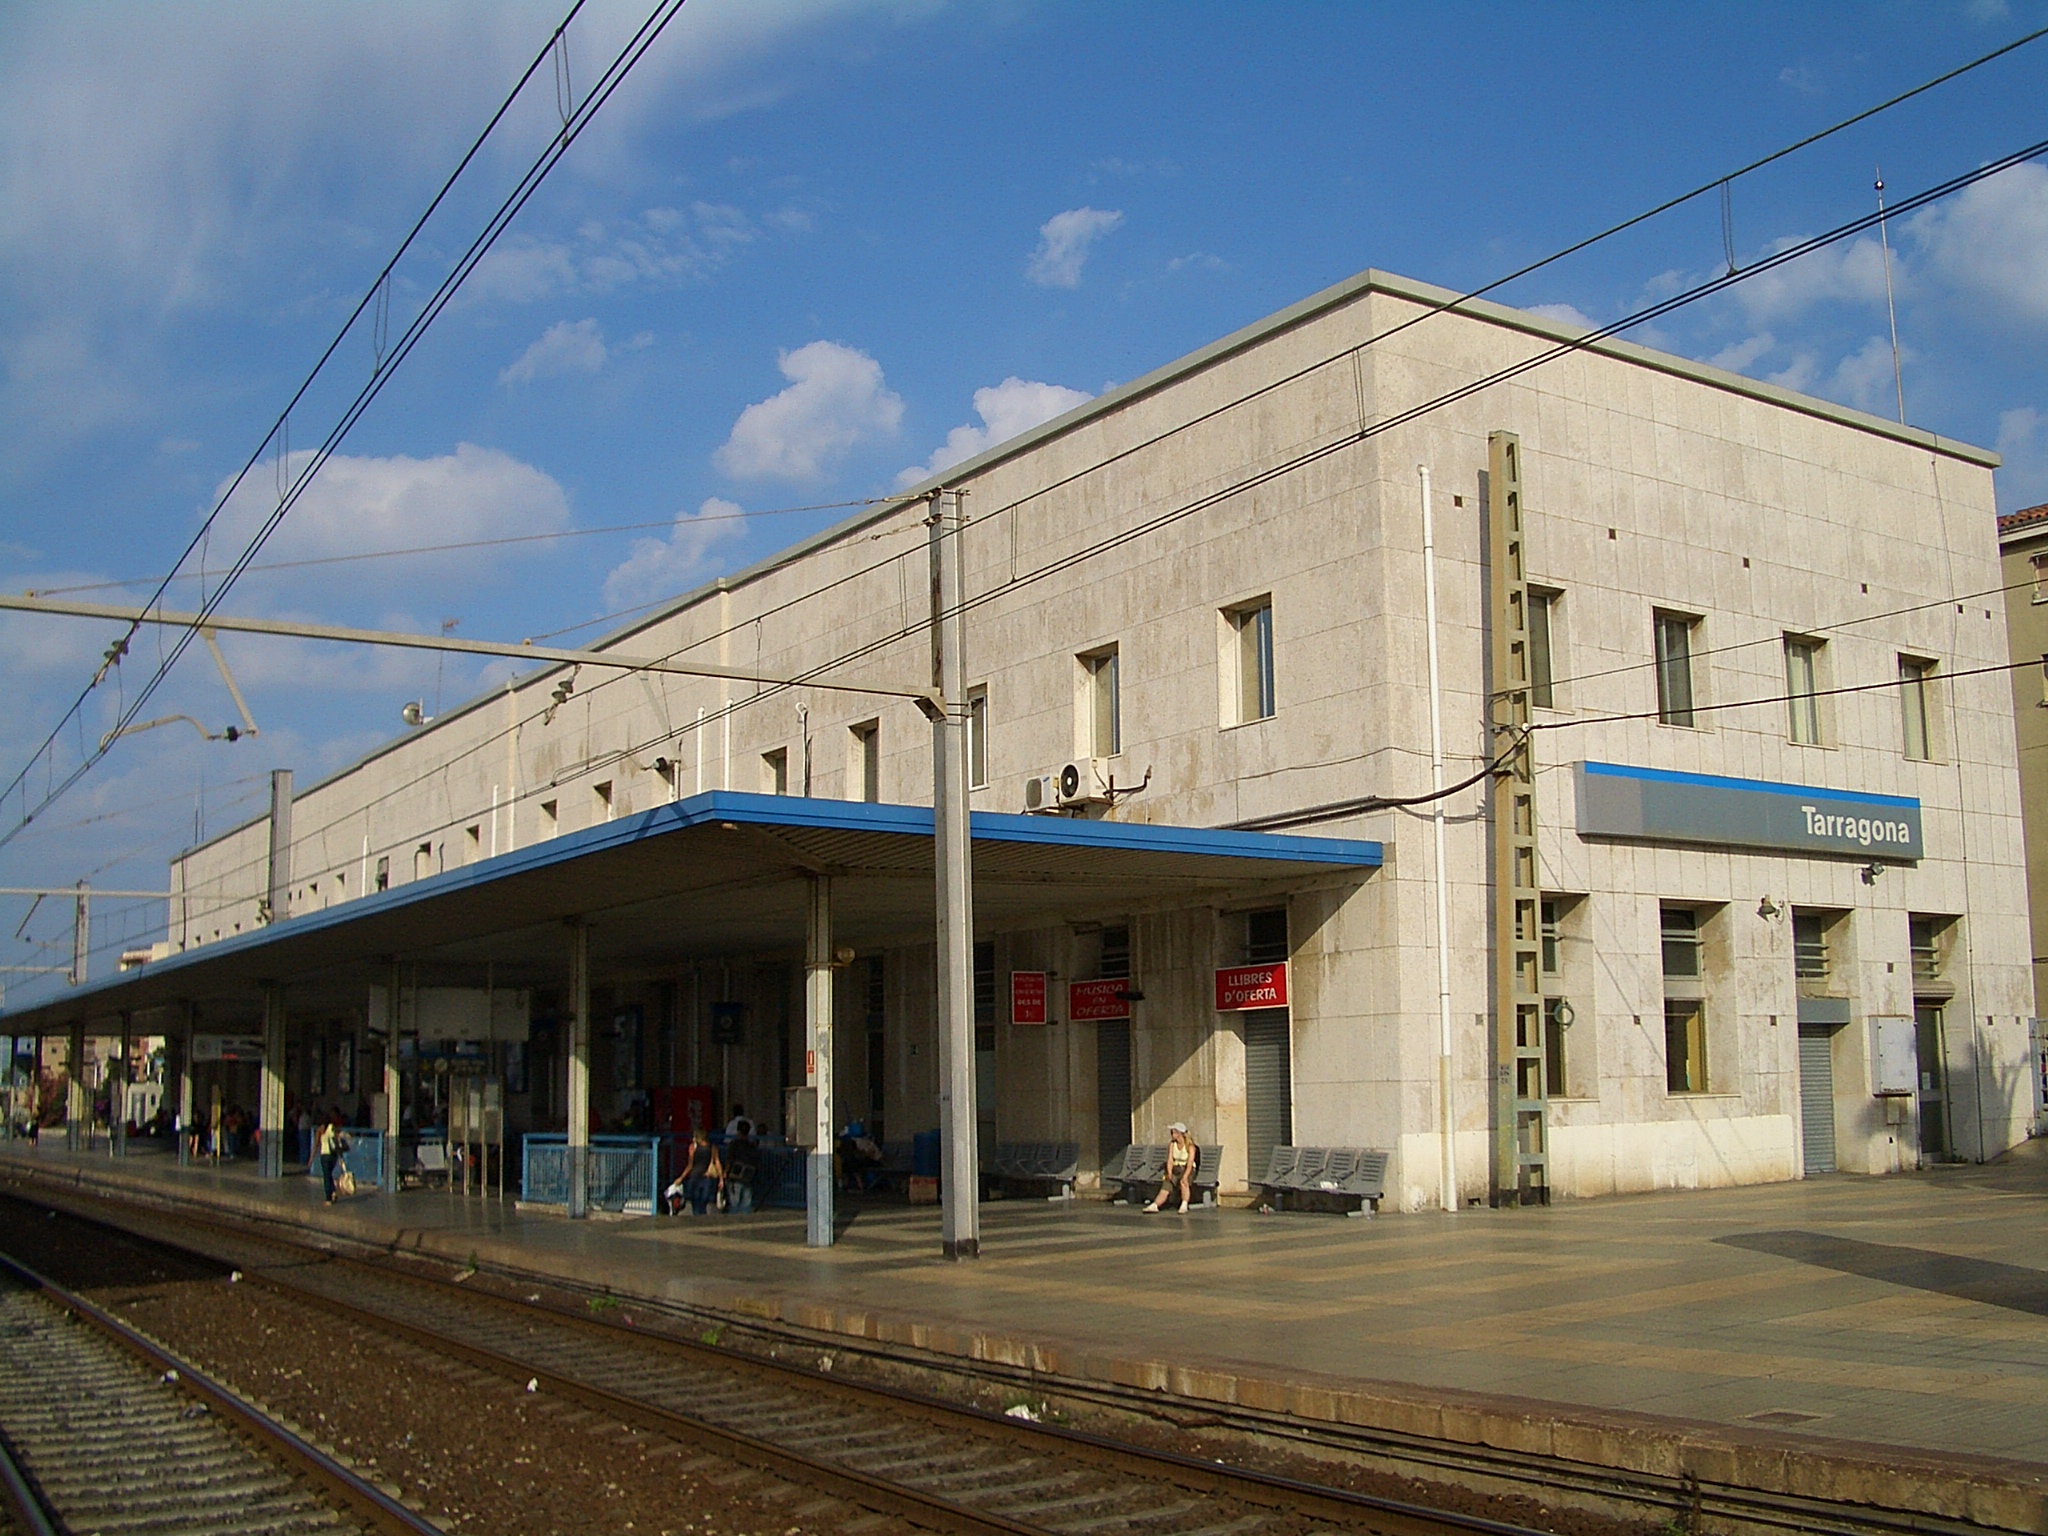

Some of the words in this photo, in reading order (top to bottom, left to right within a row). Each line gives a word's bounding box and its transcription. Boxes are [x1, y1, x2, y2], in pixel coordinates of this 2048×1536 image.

[1801, 805, 1910, 846] Tarragona
[1228, 971, 1273, 987] LLIBRES
[1092, 996, 1106, 1006] EN
[1224, 987, 1277, 1003] D'OFERTA
[1076, 1004, 1124, 1017] OFERTA
